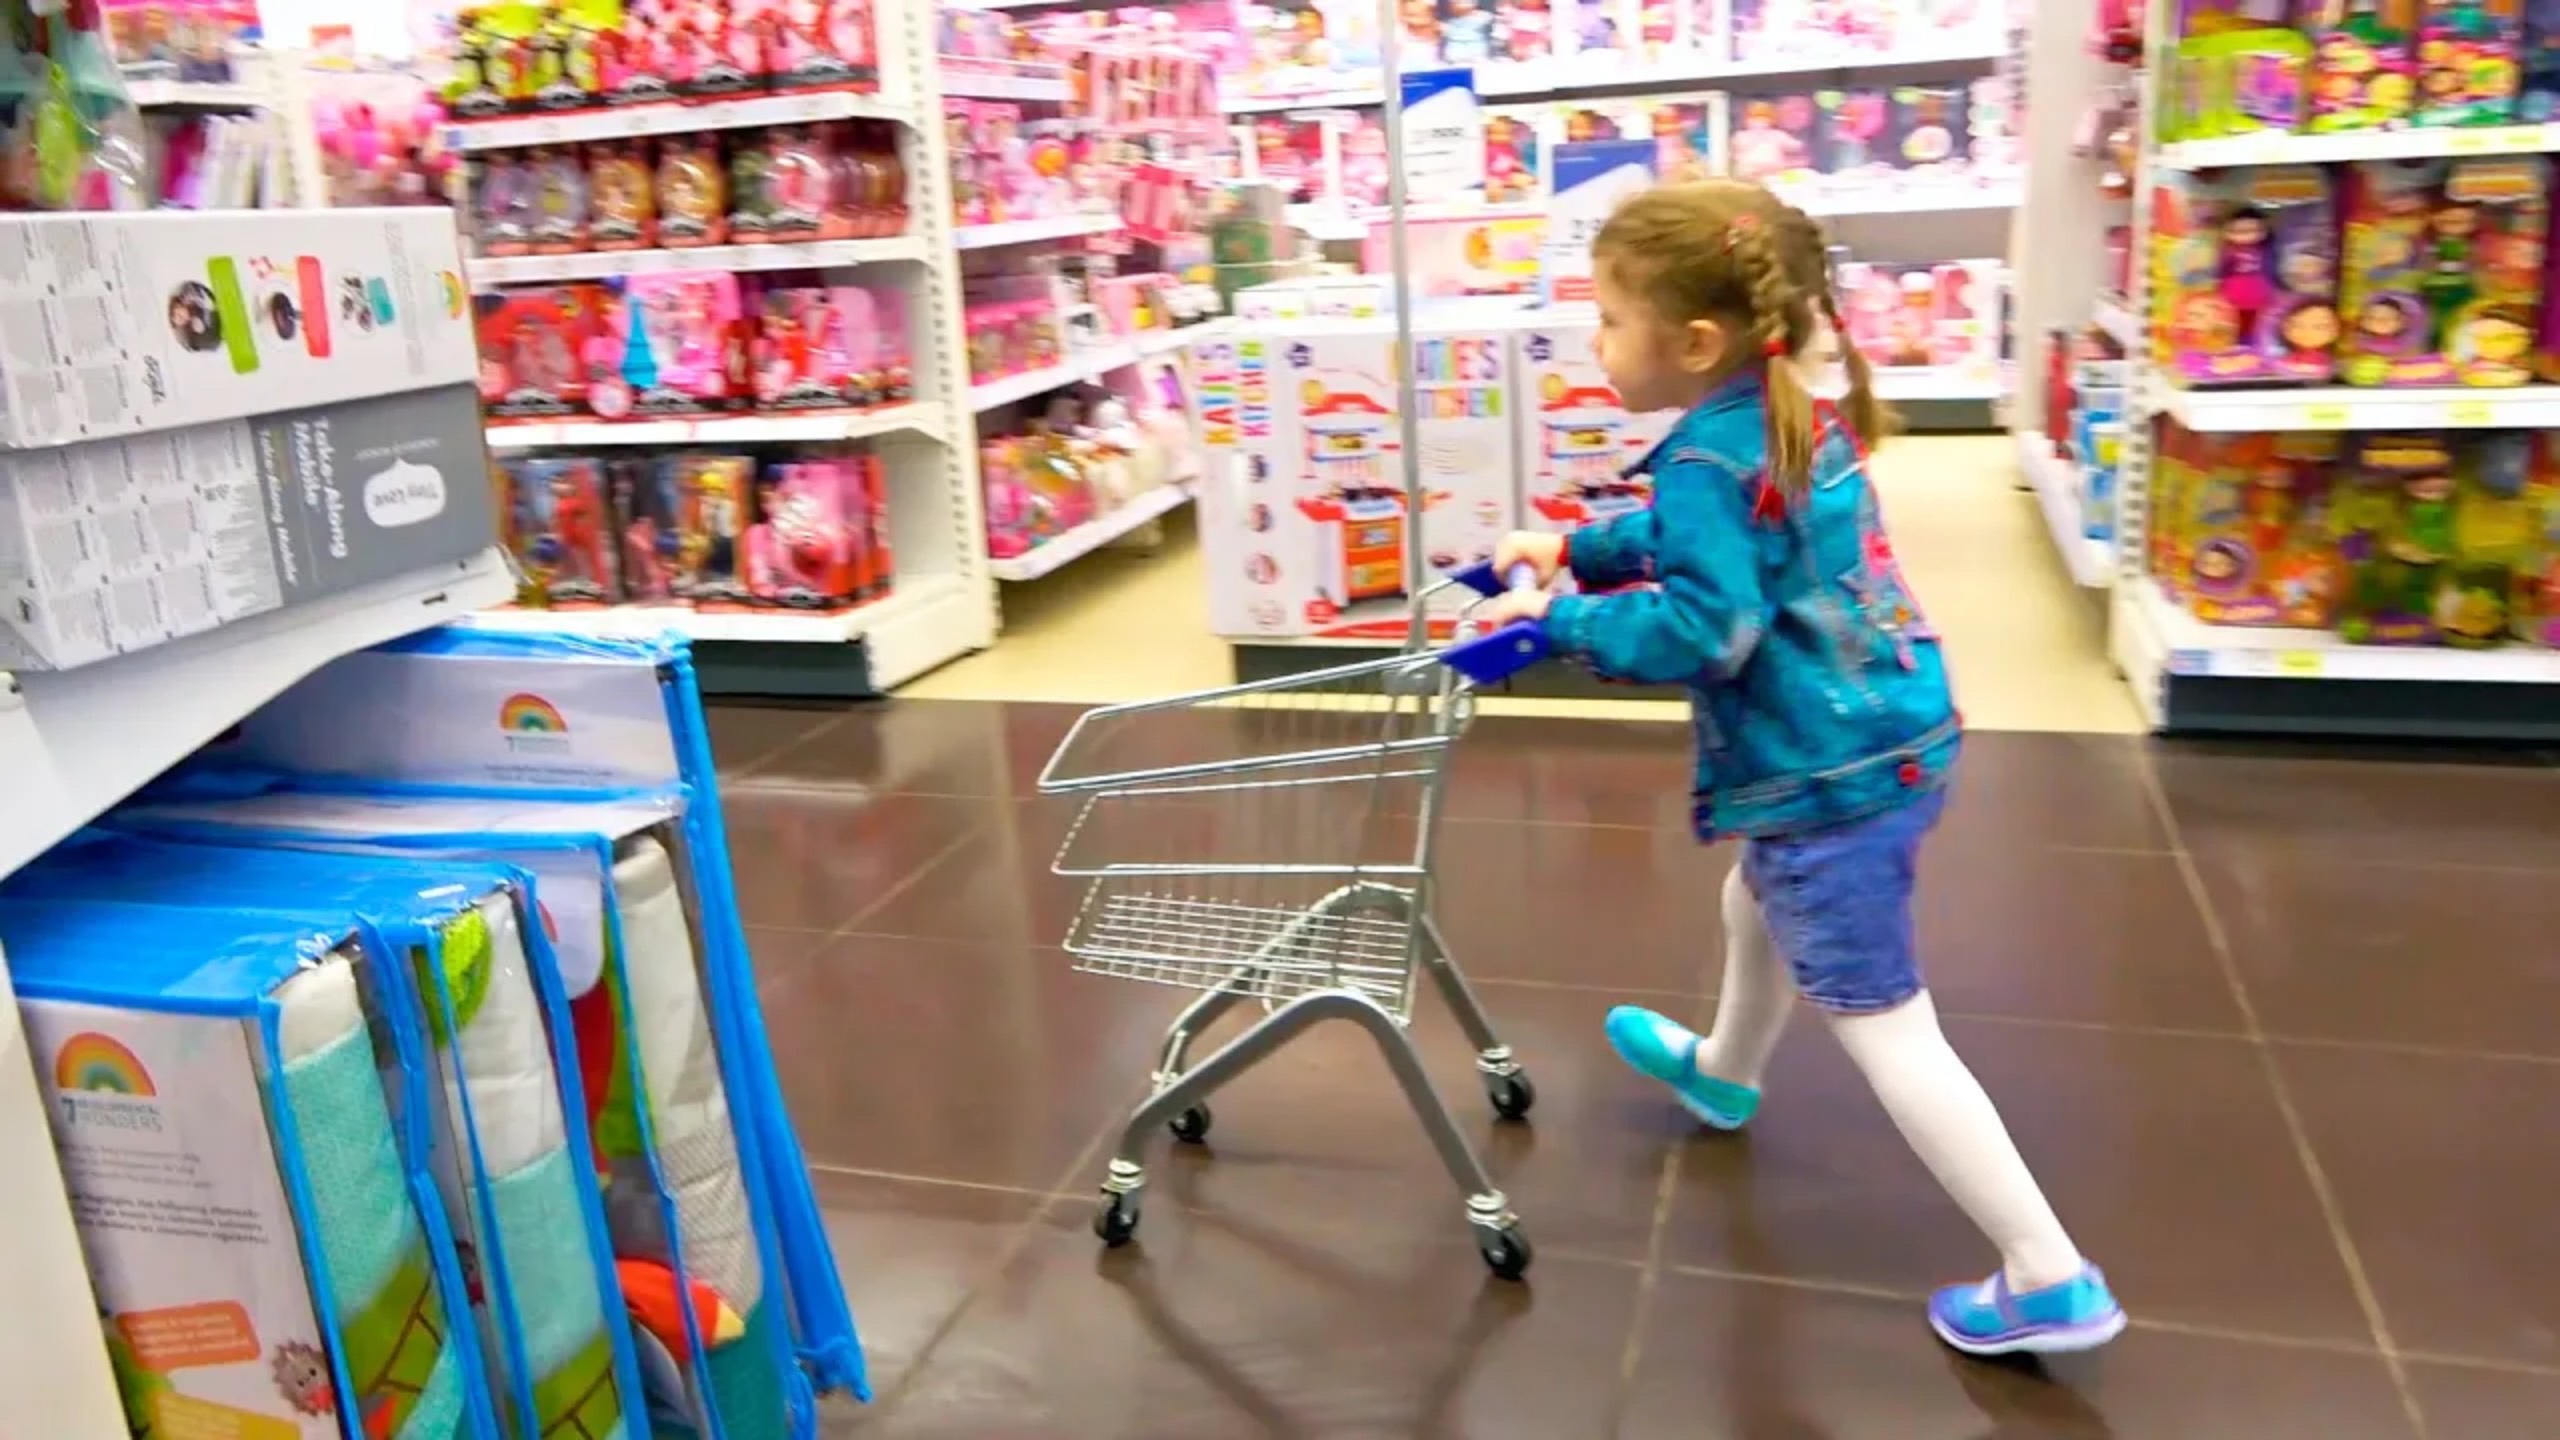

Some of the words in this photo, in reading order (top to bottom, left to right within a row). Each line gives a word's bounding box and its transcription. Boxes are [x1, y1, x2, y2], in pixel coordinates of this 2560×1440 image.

[1240, 341, 1271, 437] KITCHEN
[258, 429, 284, 524] Take-Along
[293, 421, 320, 506] Mobile
[313, 417, 348, 558] Take-Along
[276, 526, 298, 587] Mobile
[61, 1097, 76, 1123] 7
